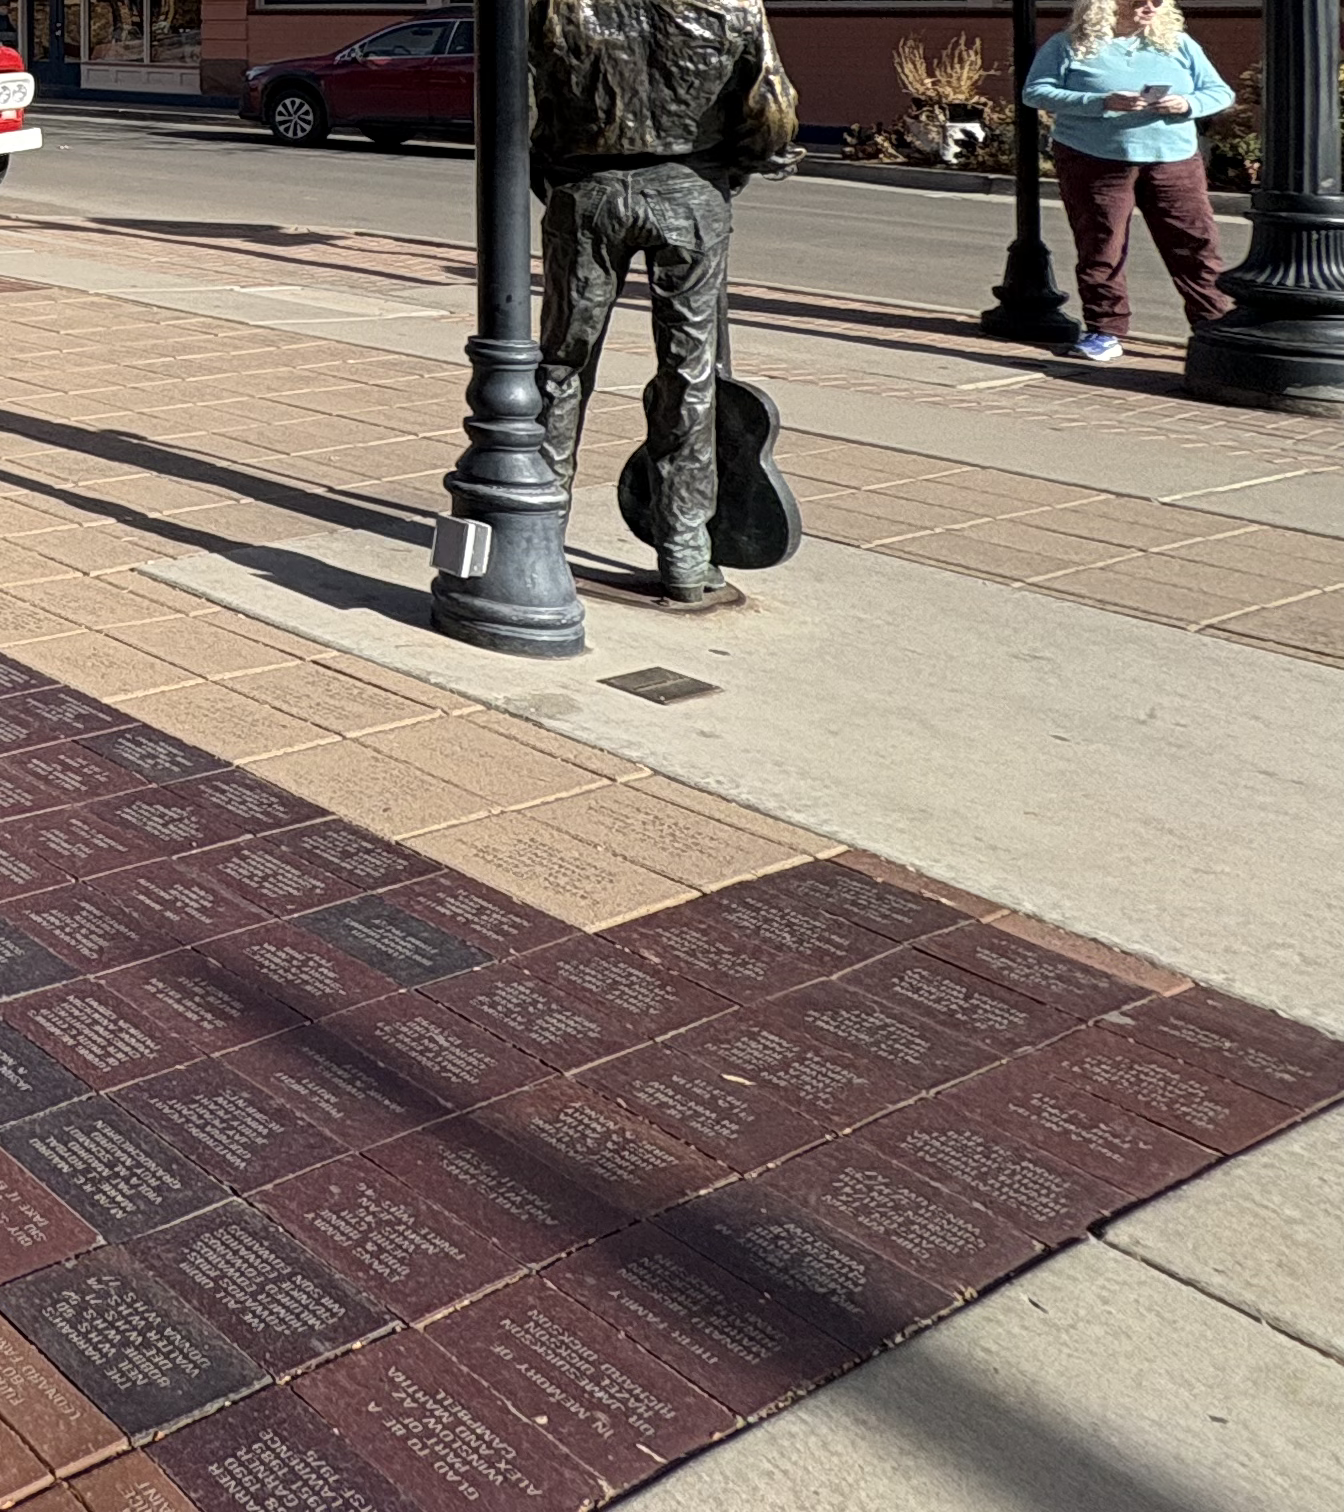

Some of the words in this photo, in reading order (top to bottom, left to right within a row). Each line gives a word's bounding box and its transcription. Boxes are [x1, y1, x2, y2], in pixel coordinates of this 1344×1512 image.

[189, 1240, 260, 1292] EDWARDS
[197, 1231, 268, 1283] EDWARDS
[210, 1227, 281, 1278] EDWARDS
[224, 1223, 295, 1274] EDWARDS
[211, 1289, 243, 1311] ALL
[253, 1291, 310, 1333] HOMER
[261, 1282, 328, 1331] MILDRED
[275, 1277, 340, 1325] FRANKIE
[288, 1272, 351, 1317] WILSON
[237, 1310, 269, 1332] WE
[521, 1307, 603, 1362] DICKSON
[140, 1345, 175, 1371] DEE
[143, 1328, 205, 1377] WALTER
[158, 1325, 214, 1368] DONNA
[488, 1342, 516, 1360] OF
[519, 1320, 601, 1375] DICKSON
[101, 1364, 136, 1390] THE
[111, 1354, 151, 1385] NEIL
[125, 1349, 174, 1388] BOBBIE
[509, 1359, 596, 1420] MEMORY
[18, 1363, 84, 1420] LEONARD
[361, 1400, 384, 1415] A
[379, 1364, 460, 1424] MARTHA
[388, 1388, 420, 1410] AZ
[594, 1375, 658, 1418] HAZEL
[596, 1362, 681, 1419] RICHARD
[377, 1414, 409, 1436] BE
[397, 1414, 427, 1434] OF
[425, 1387, 524, 1460] CAMPBELL
[450, 1424, 497, 1457] AND
[586, 1417, 618, 1438] IN
[403, 1436, 434, 1457] TO
[420, 1433, 474, 1473] PART
[428, 1458, 485, 1500] GLAD
[490, 1457, 546, 1497] ALEX
